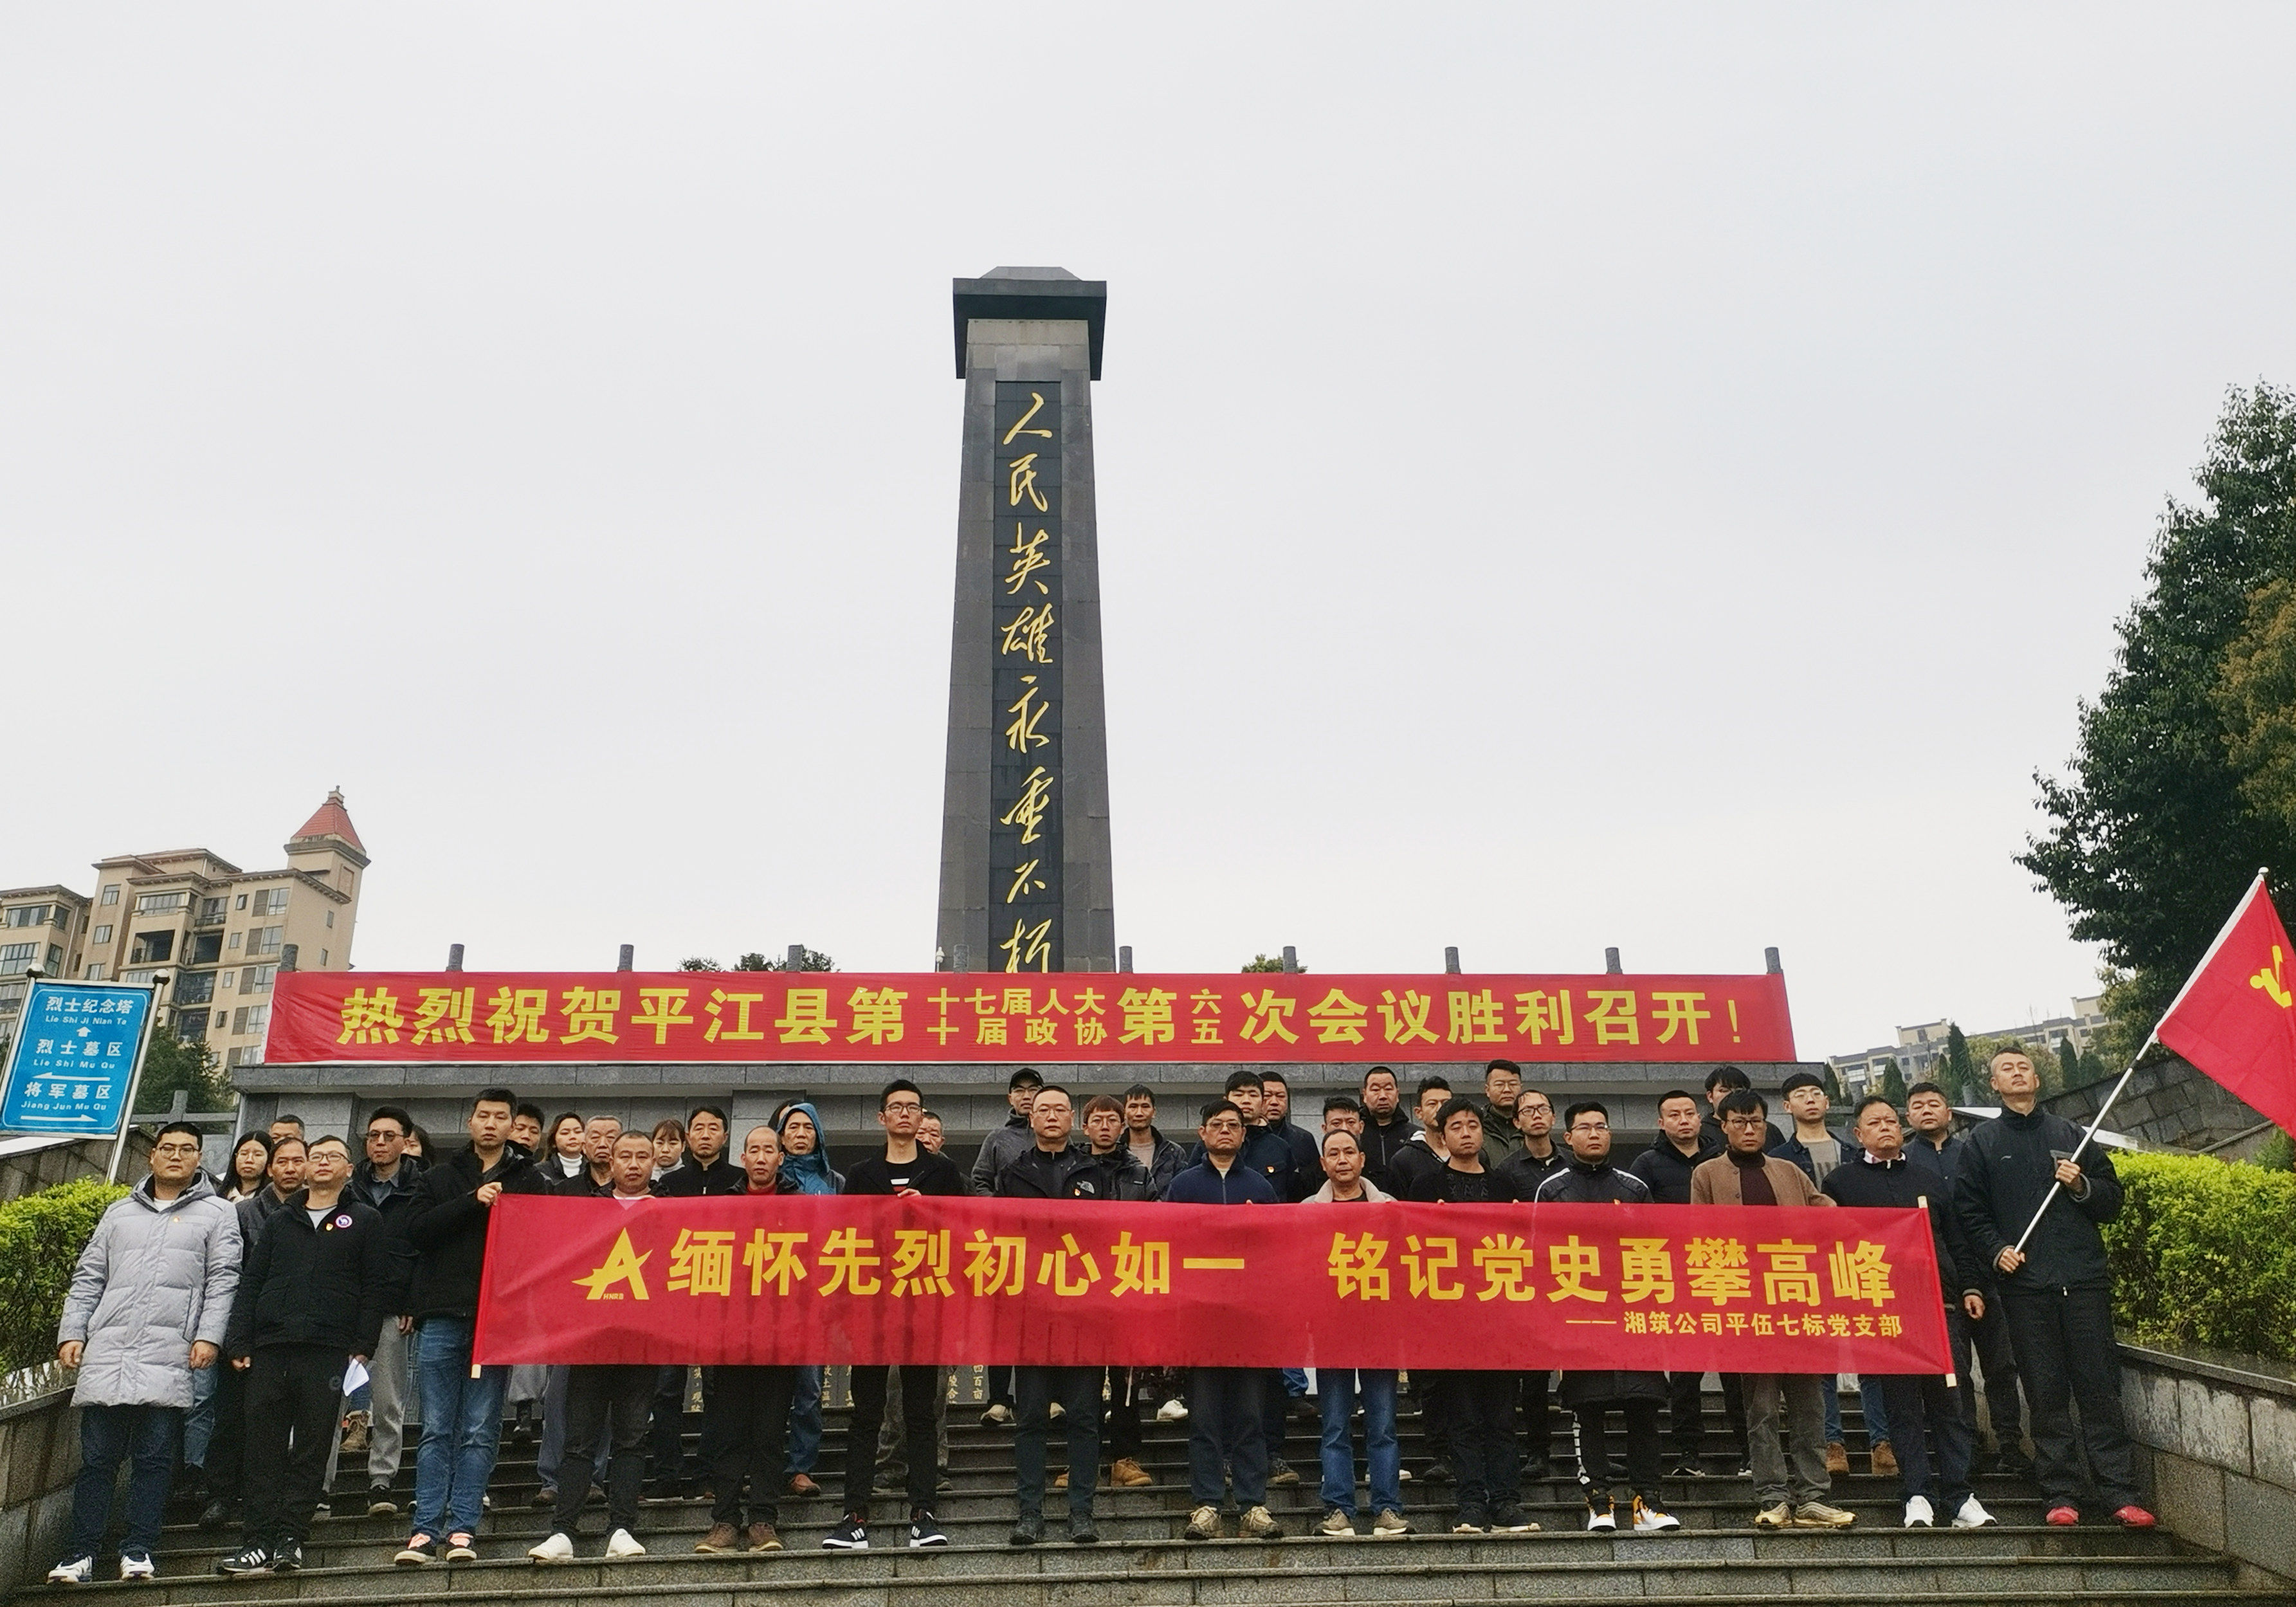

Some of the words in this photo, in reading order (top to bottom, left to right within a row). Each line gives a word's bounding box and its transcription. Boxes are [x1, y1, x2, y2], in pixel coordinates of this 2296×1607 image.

[45, 996, 134, 1014] 烈士纪念塔
[927, 987, 1106, 1015] 十七届人大
[1190, 989, 1222, 1015] 六
[336, 986, 907, 1045] 热烈祝贺平江县第
[1117, 987, 1177, 1045] 第
[927, 1017, 1107, 1045] 十届政协
[1191, 1018, 1223, 1043] 五
[36, 1038, 123, 1056] 烈士墓区
[24, 1081, 112, 1099] 将军墓区
[21, 1101, 50, 1110] Jiang
[668, 1227, 1244, 1298] 缅怀先烈初心如一
[1328, 1233, 1895, 1307] 铭记党史勇攀高峰
